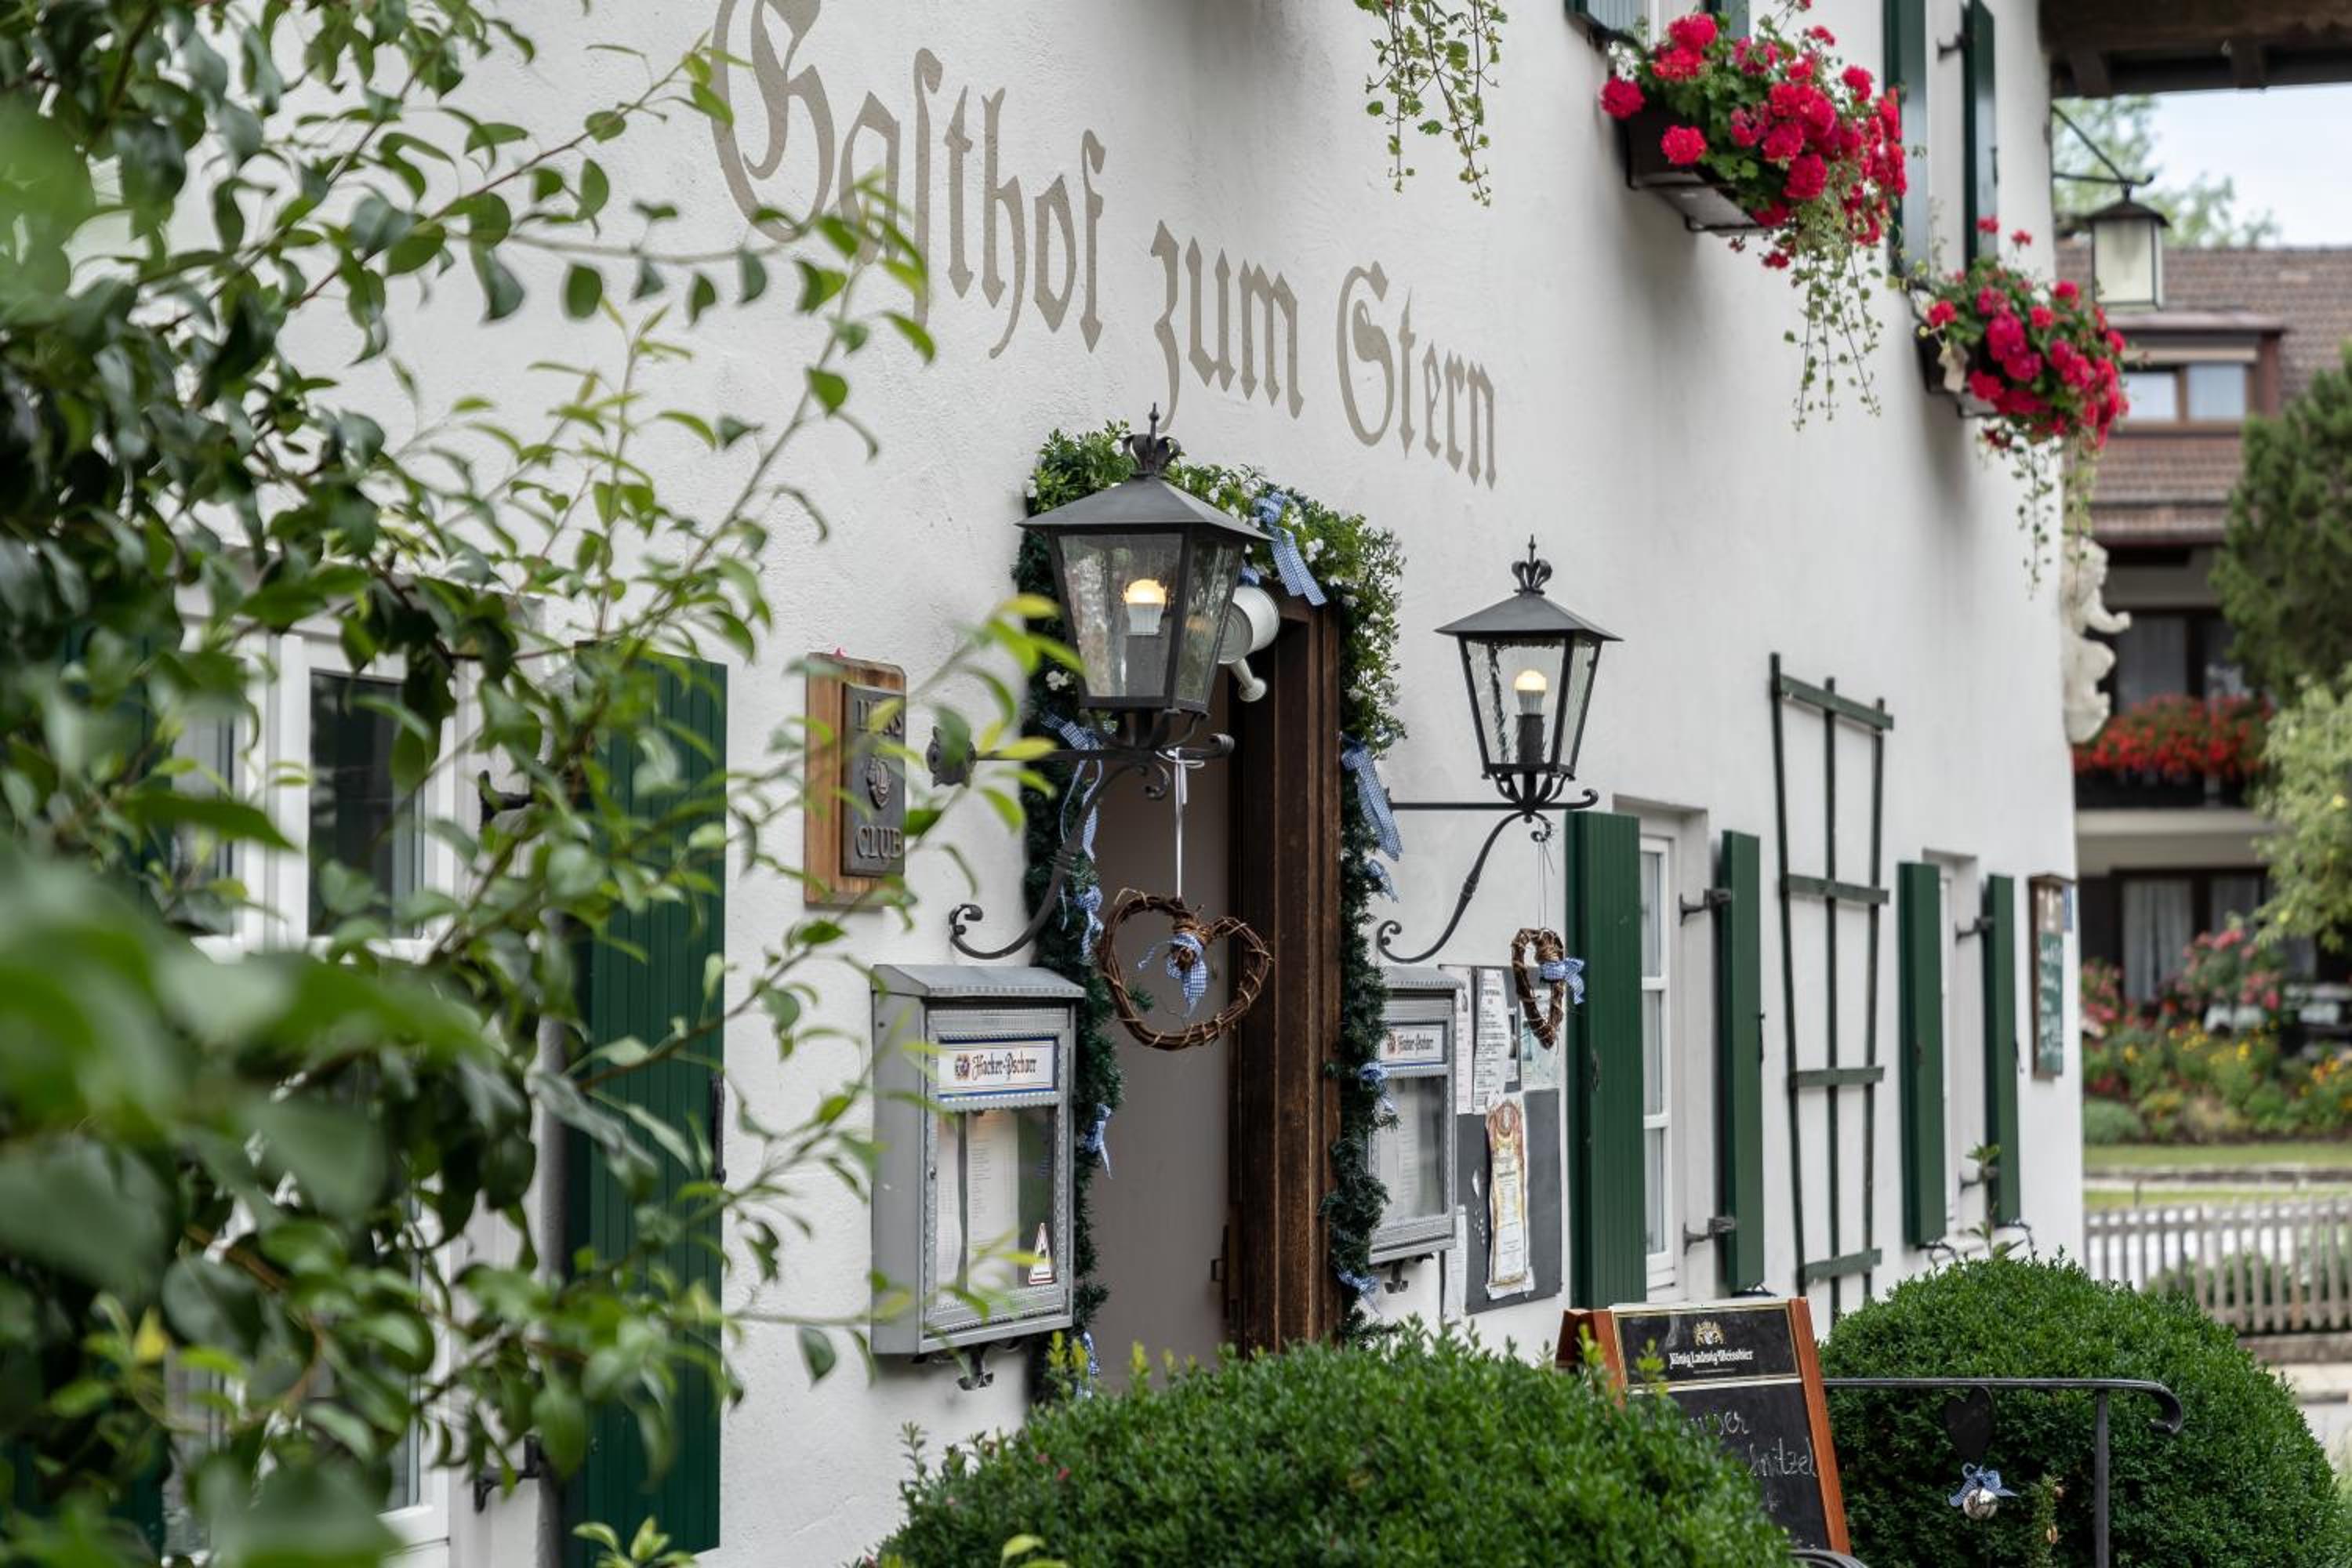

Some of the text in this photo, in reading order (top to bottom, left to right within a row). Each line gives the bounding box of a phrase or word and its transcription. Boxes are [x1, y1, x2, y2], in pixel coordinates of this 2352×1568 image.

[1150, 220, 1304, 433] zum
[1337, 260, 1496, 490] Stern
[855, 826, 903, 859] CLUB
[971, 1050, 1037, 1081] Hacker-Pschorr
